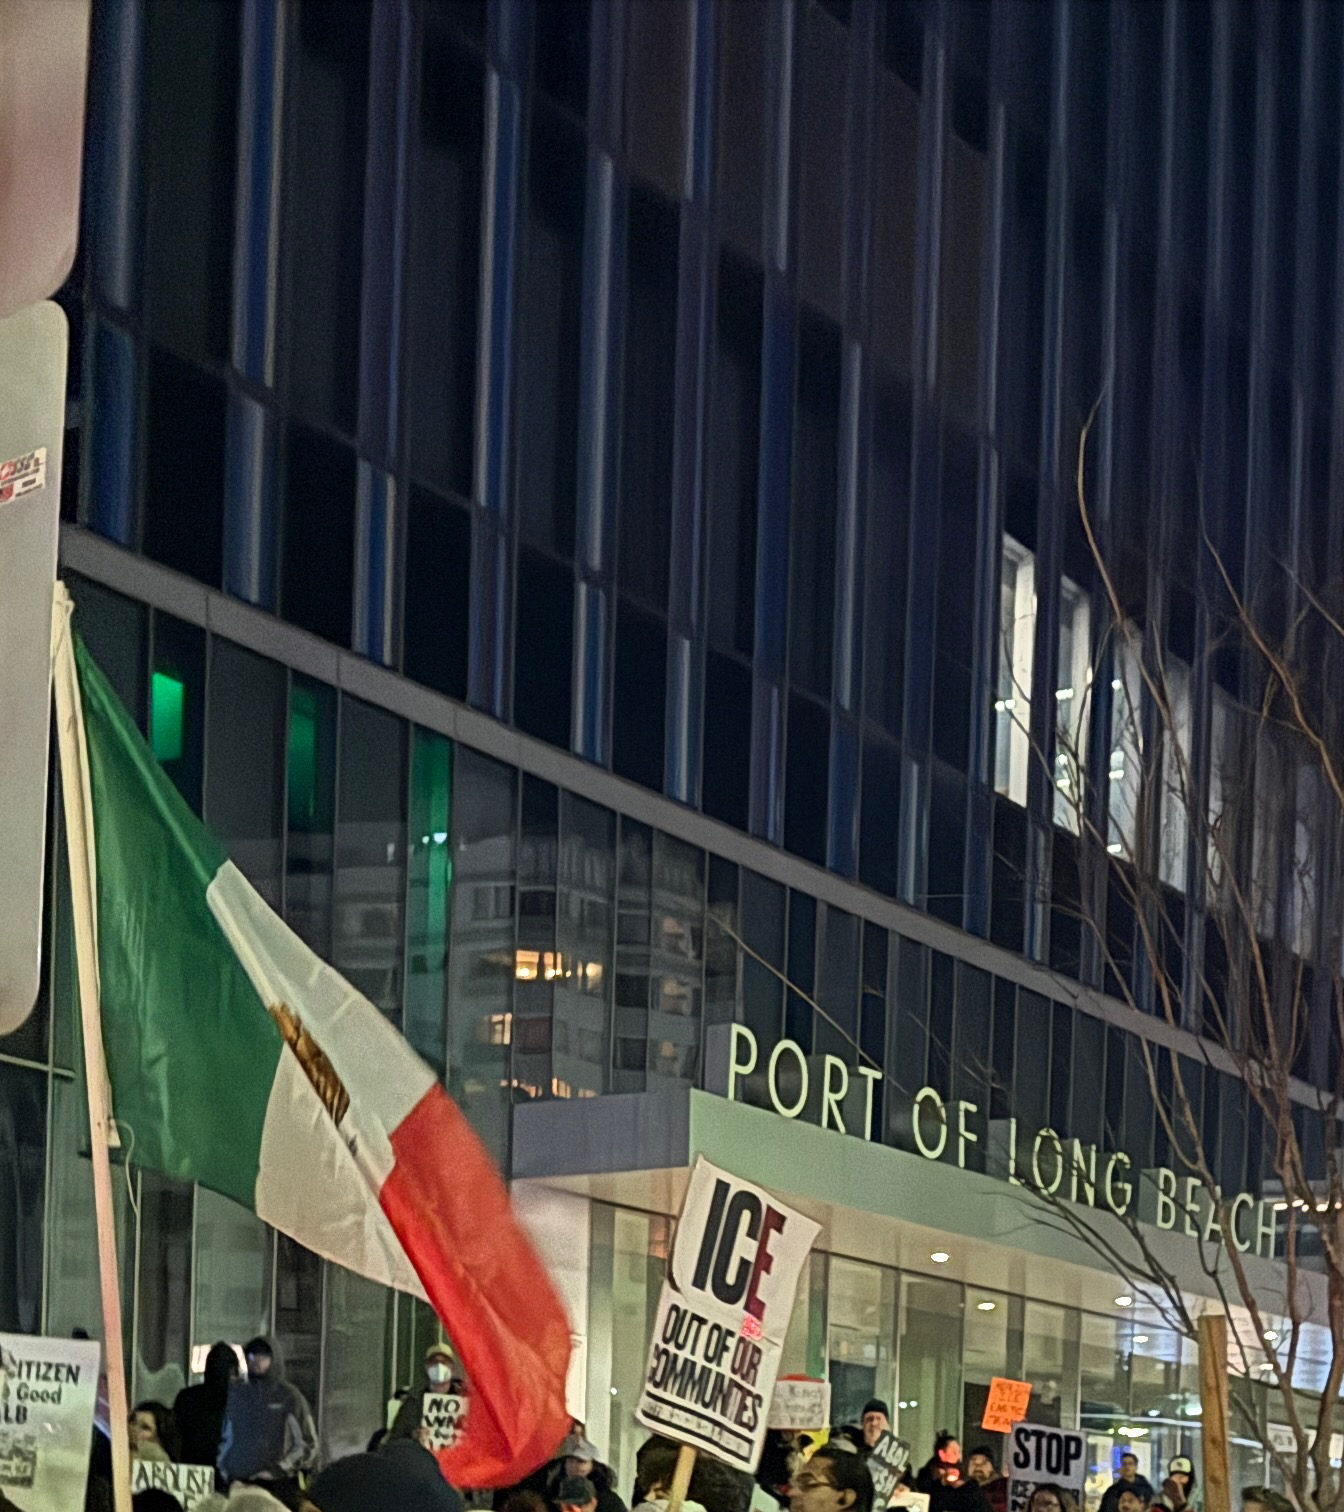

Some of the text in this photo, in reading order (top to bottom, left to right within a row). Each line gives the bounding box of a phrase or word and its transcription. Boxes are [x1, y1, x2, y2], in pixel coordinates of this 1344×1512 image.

[727, 1022, 1277, 1260] PORT OF LONG BEACH
[691, 1177, 787, 1322] ICE
[661, 1304, 762, 1387] OUT OF OUR
[16, 1382, 63, 1406] Good
[428, 1397, 461, 1413] NO
[1013, 1427, 1083, 1476] STOP
